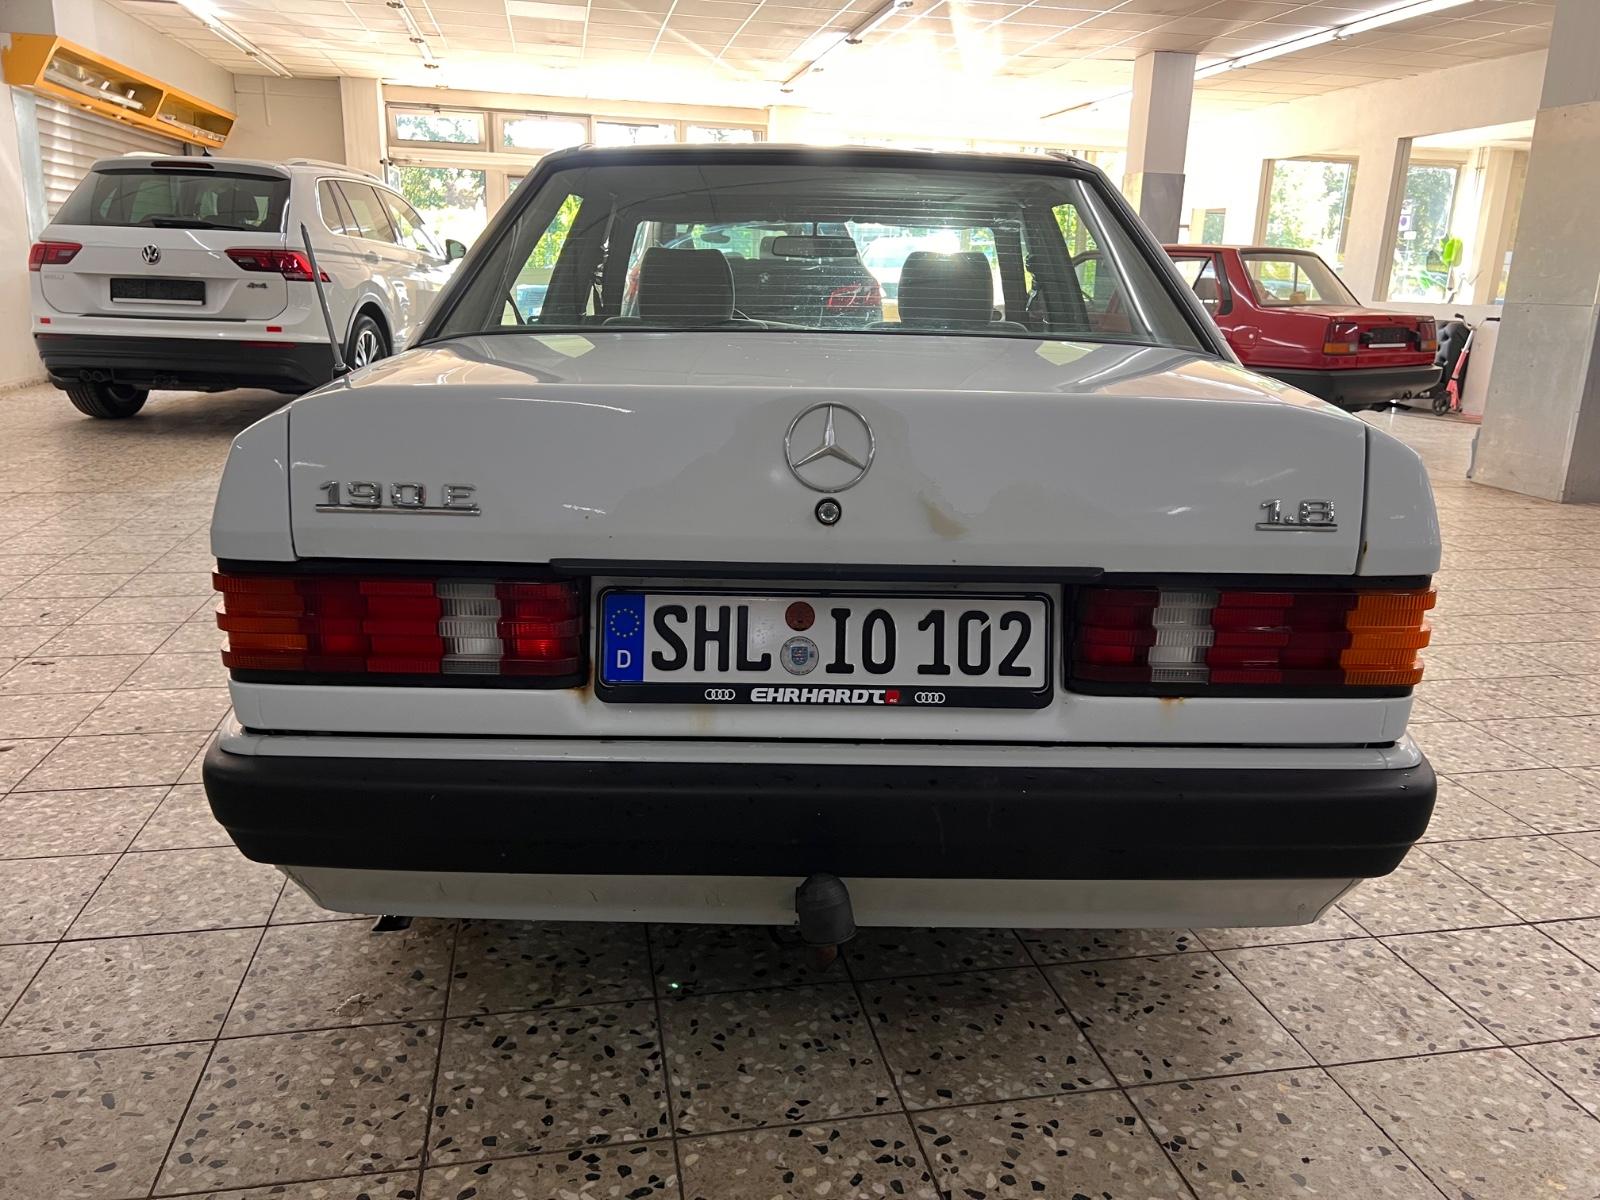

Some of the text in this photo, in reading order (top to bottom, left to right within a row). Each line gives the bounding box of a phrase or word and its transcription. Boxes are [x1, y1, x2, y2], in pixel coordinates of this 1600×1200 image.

[320, 481, 477, 507] 190 E
[1260, 500, 1335, 524] 1.8
[651, 605, 772, 672] SHL
[825, 608, 896, 674] IO
[917, 610, 1031, 677] 102
[616, 649, 631, 669] D
[750, 687, 886, 704] EHRHARDT
